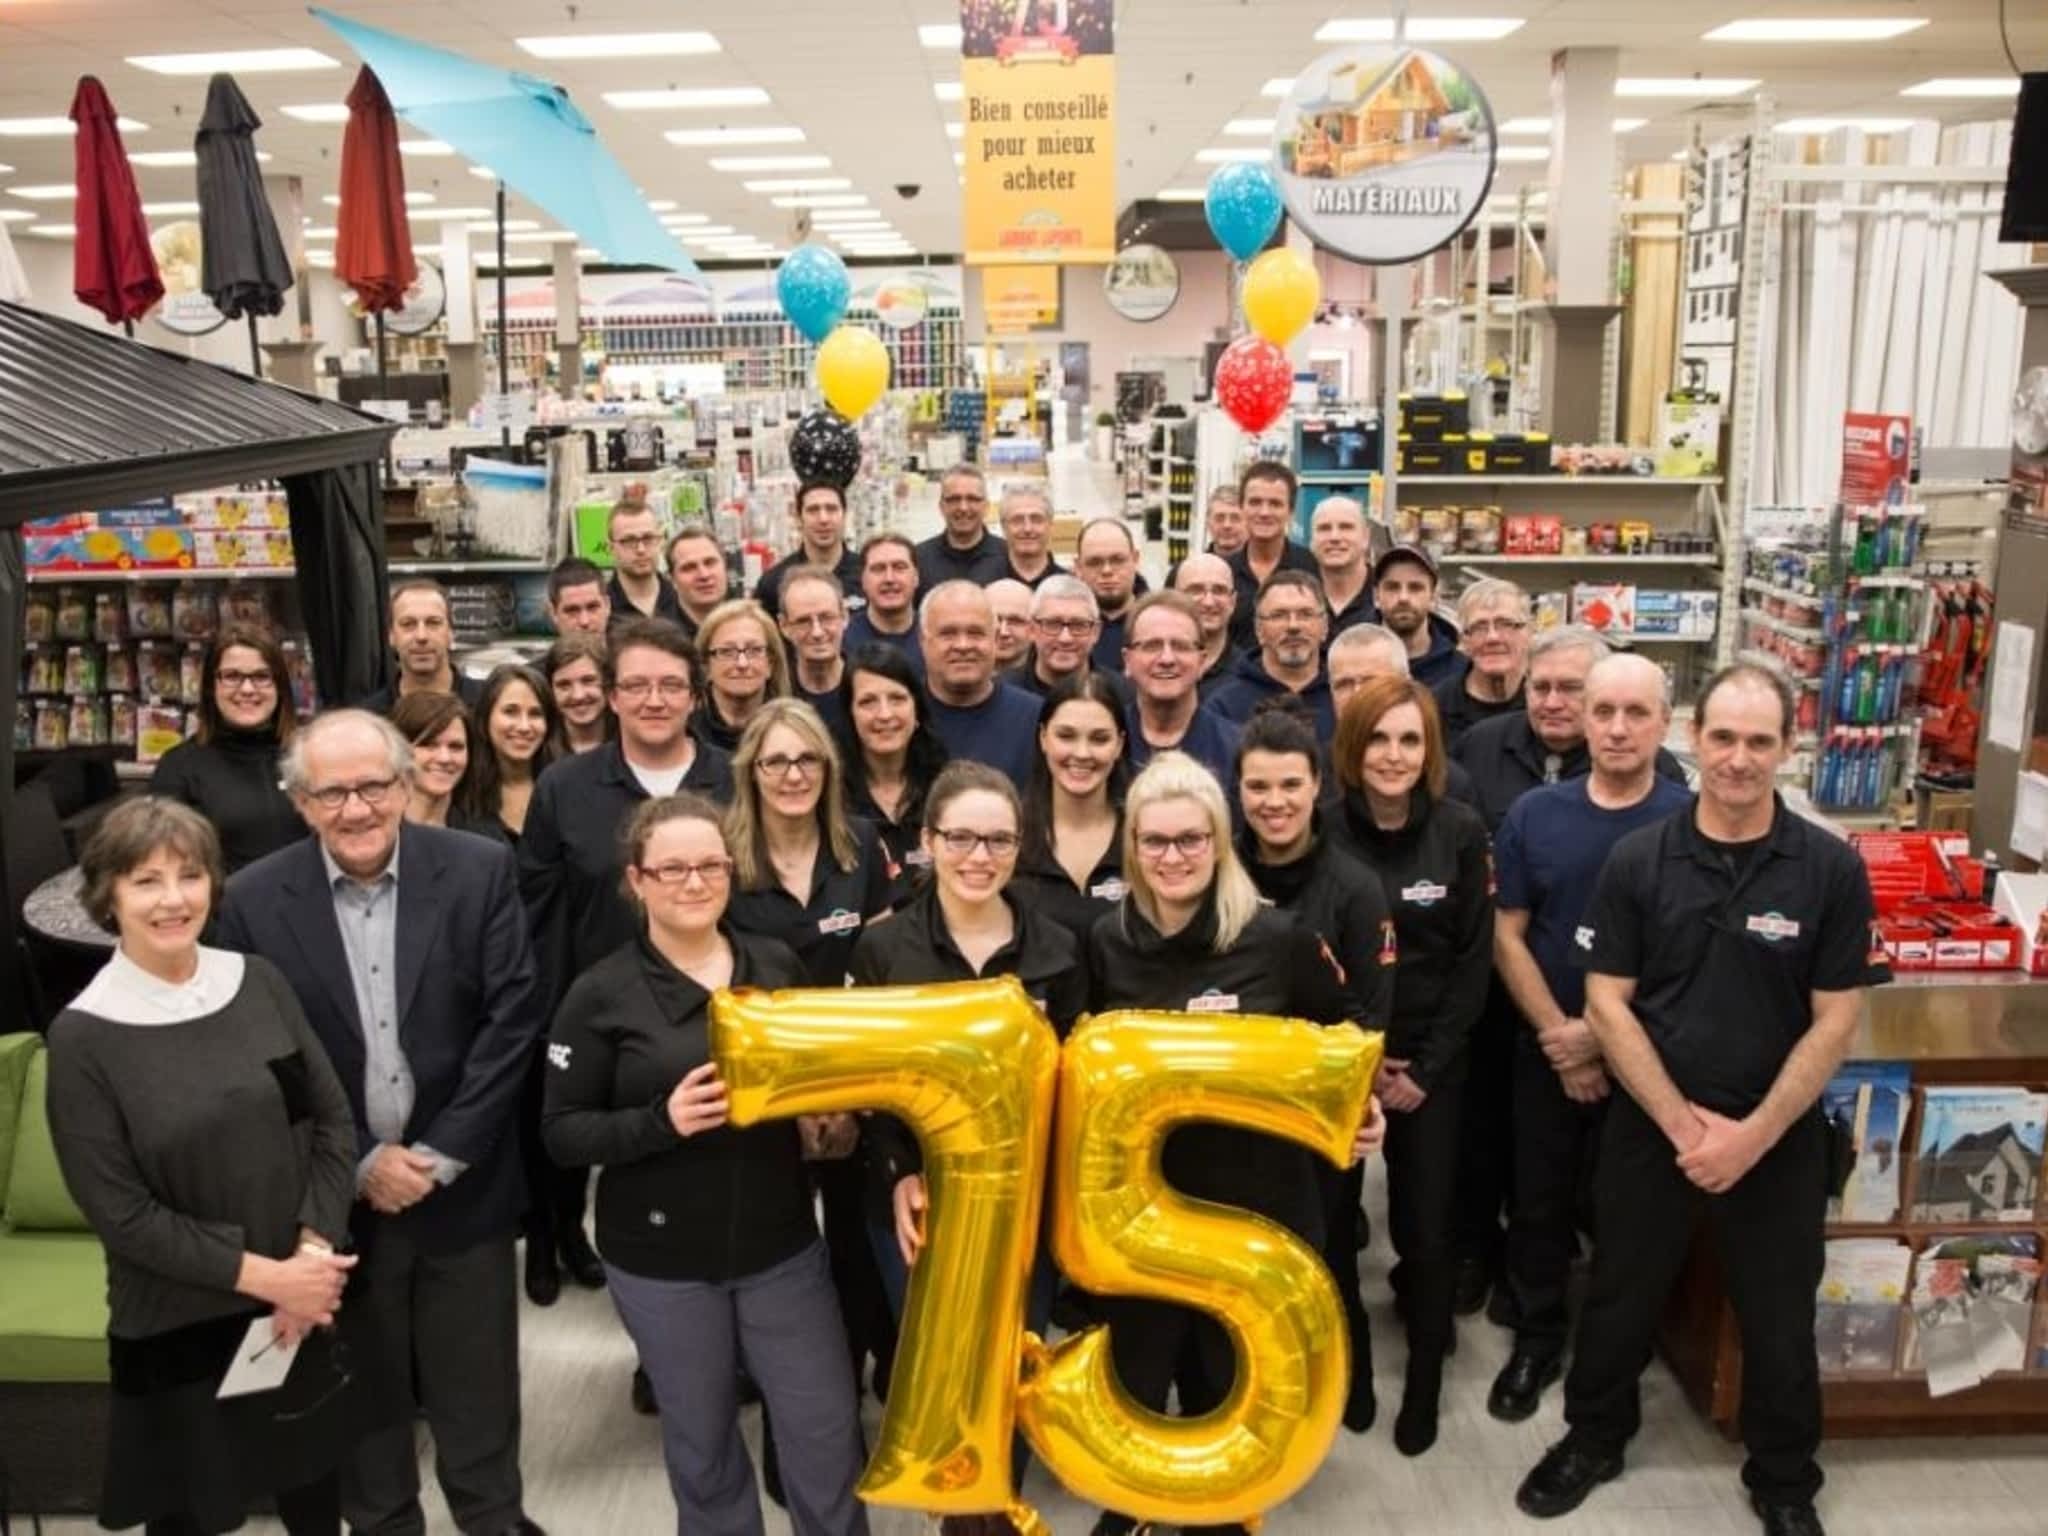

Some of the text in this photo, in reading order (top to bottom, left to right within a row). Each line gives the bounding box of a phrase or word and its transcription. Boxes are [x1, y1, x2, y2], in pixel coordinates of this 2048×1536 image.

[969, 93, 1109, 123] Bien conseillé
[983, 129, 1096, 162] pour mieux
[1003, 163, 1076, 191] acheter
[1312, 181, 1461, 217] MATÉRIAUX
